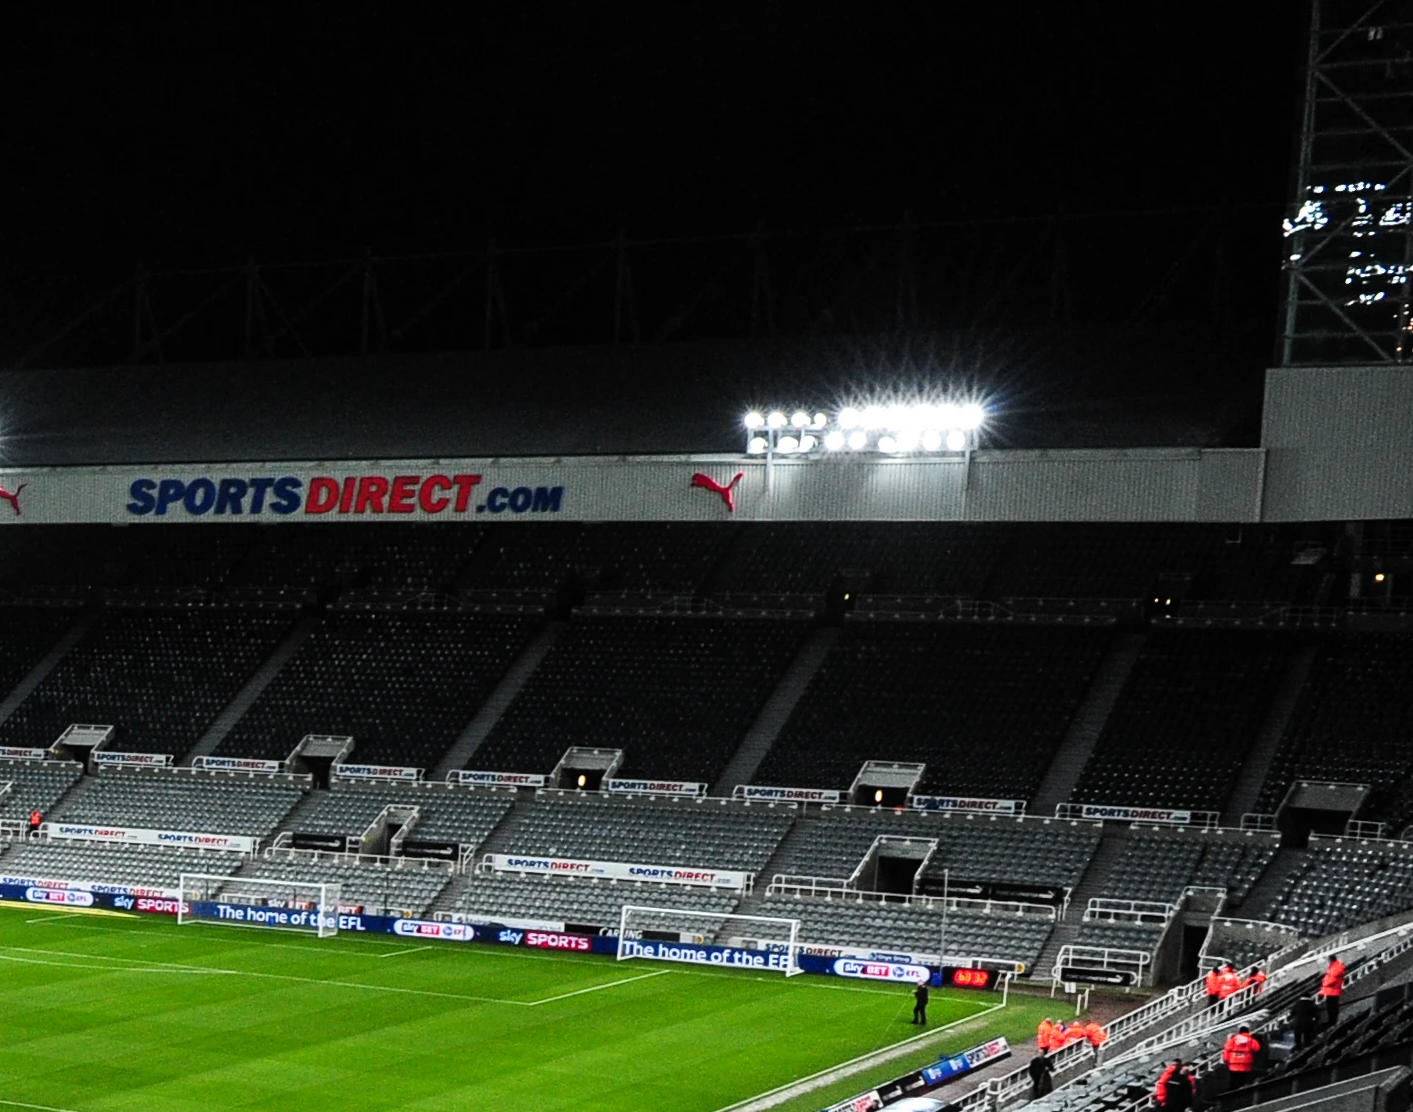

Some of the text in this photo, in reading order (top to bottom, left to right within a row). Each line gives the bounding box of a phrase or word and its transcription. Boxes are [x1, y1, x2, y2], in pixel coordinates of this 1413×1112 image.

[126, 474, 564, 515] SPORTSDIRECT.COM
[916, 796, 1013, 811] SRTSDIRECT
[114, 896, 189, 913] sky SPORTS
[217, 905, 243, 921] The
[247, 906, 285, 924] home
[289, 909, 306, 926] of
[339, 915, 365, 931] EFL
[499, 929, 588, 949] sky SPORTS
[599, 926, 642, 940] CARING
[623, 940, 792, 969] The home of the EF
[765, 942, 856, 958] SPOSDIRECT
[843, 961, 864, 974] sky
[867, 965, 887, 976] BET
